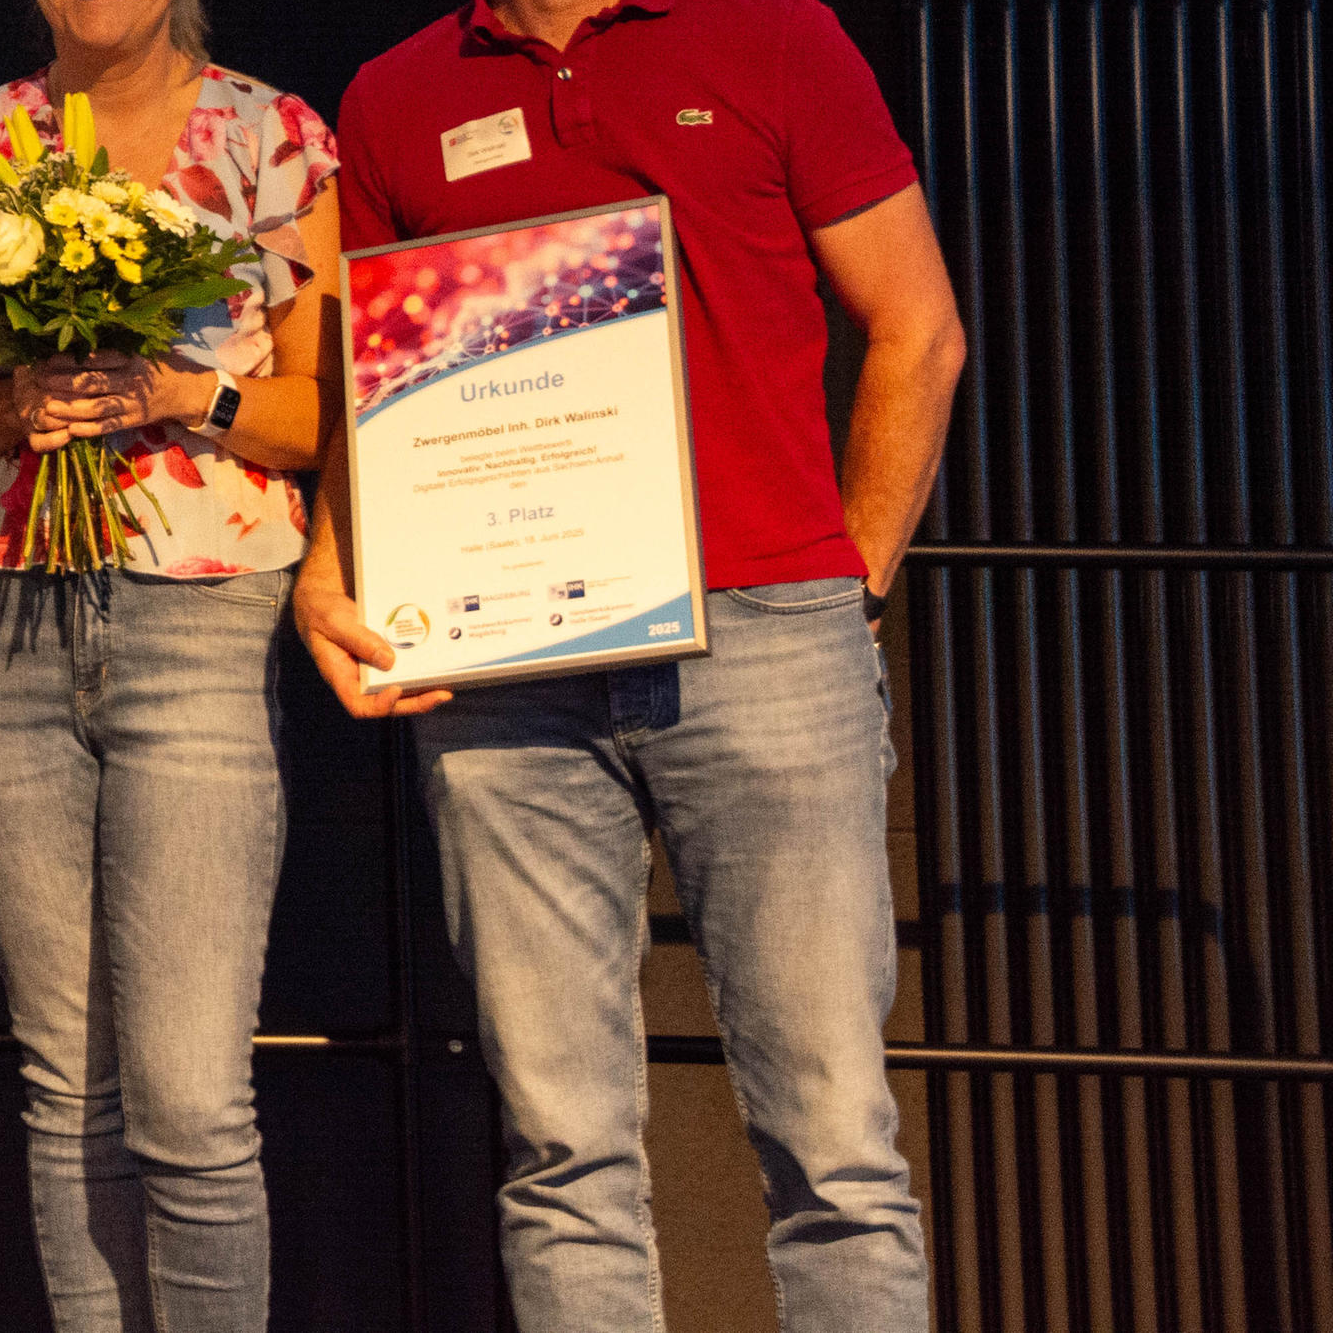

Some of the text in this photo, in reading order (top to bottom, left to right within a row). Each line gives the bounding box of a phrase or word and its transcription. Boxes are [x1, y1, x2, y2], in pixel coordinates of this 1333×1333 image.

[460, 371, 565, 402] Urkunde
[413, 405, 618, 448] Zwergenmöbel Inh. Dirk Walinski
[487, 505, 555, 527] 3. Platz
[648, 621, 680, 636] 2025
